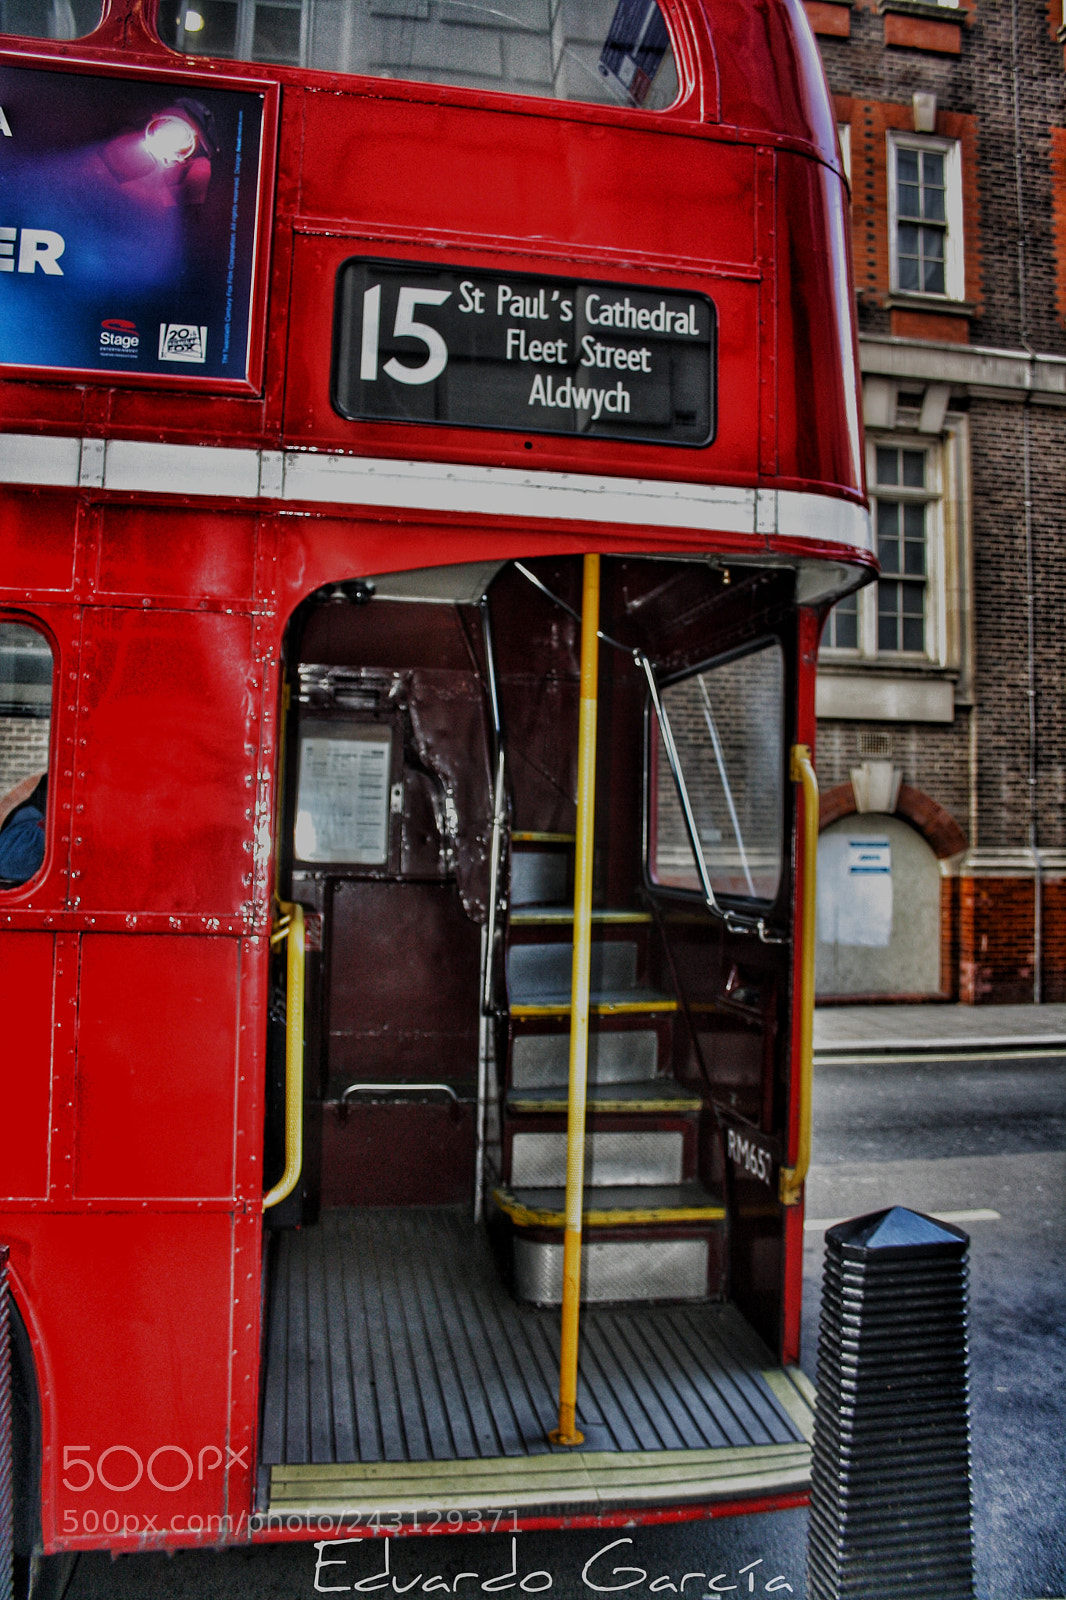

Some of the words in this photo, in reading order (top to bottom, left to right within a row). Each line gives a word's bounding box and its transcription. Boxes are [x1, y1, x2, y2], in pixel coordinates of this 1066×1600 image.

[0, 227, 66, 276] ER
[458, 281, 486, 314] St
[496, 285, 573, 322] Paul's
[585, 294, 700, 335] Cathedral
[100, 332, 139, 349] Stage
[360, 284, 452, 385] 15
[506, 329, 568, 364] Fleet
[580, 335, 652, 373] Street
[528, 374, 631, 420] Aldwych
